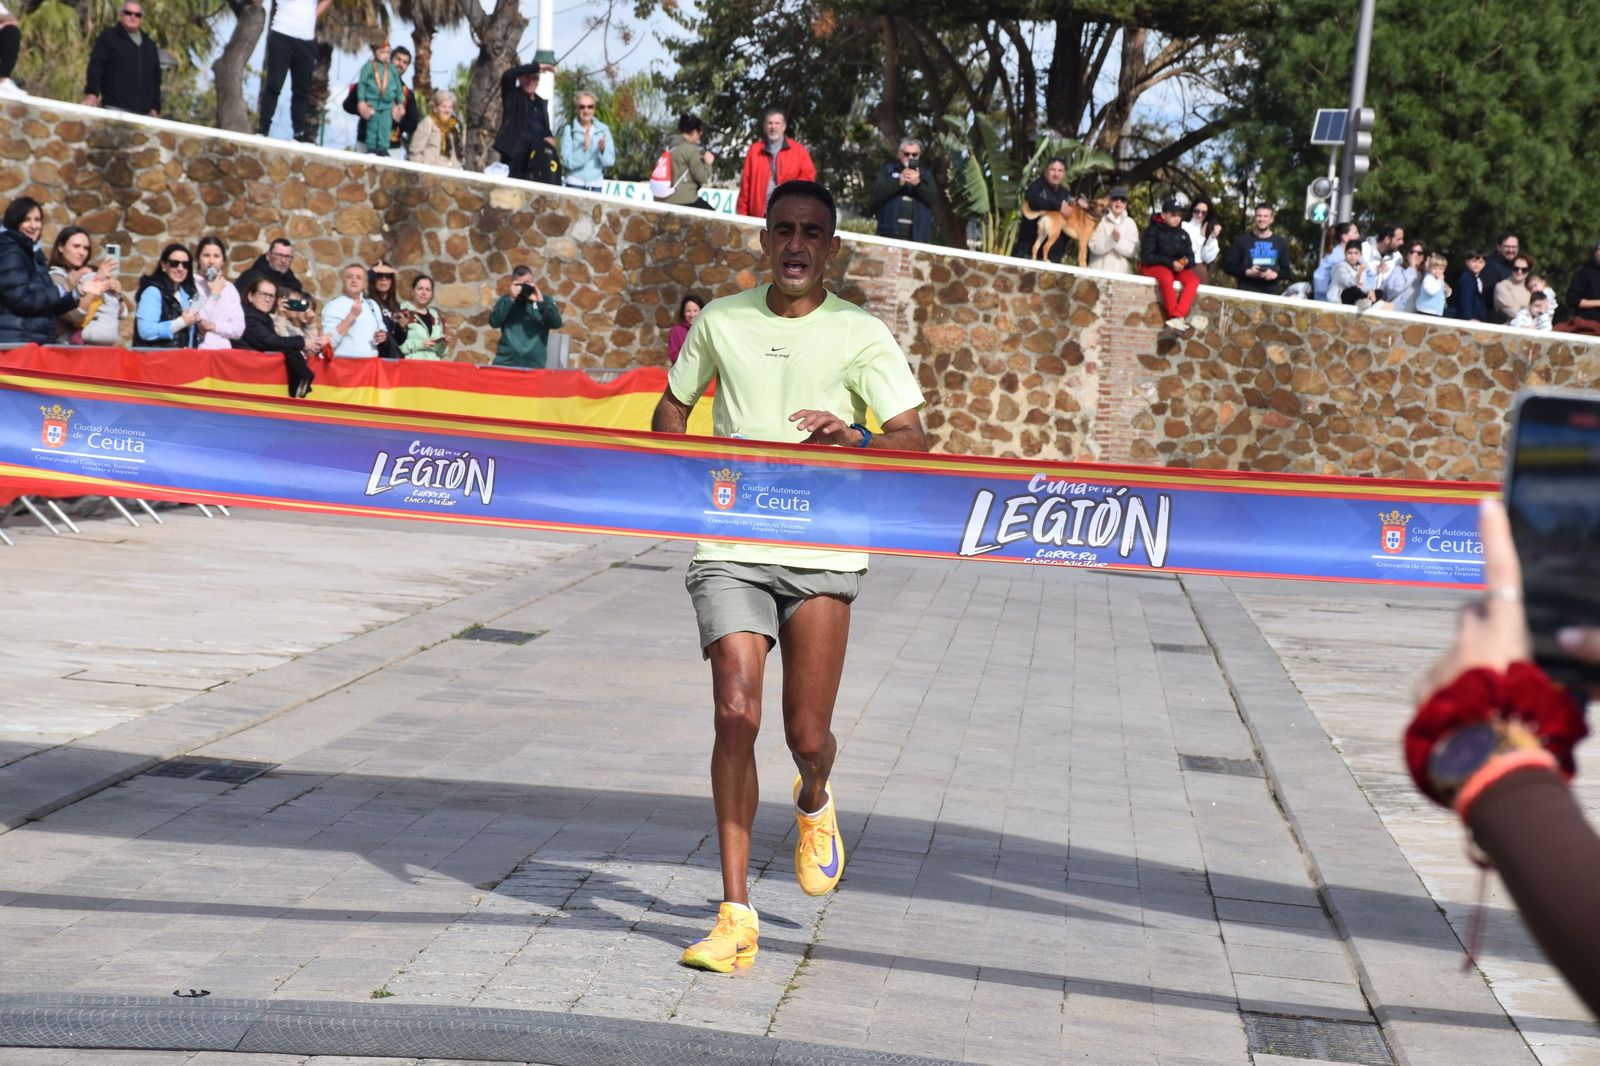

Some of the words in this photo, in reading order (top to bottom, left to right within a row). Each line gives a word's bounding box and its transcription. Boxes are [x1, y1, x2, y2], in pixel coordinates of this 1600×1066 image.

[74, 422, 102, 434] Ciudad
[103, 425, 146, 437] Autónoma
[72, 430, 84, 440] de
[87, 432, 145, 453] Ceuta
[408, 440, 445, 457] Cuna
[365, 451, 496, 505] LEGIÓN
[1028, 472, 1087, 494] Cuna
[742, 484, 769, 492] Ciudad
[770, 486, 811, 495] Autónoma
[741, 492, 752, 500] de
[755, 492, 811, 512] Ceuta
[959, 487, 1170, 568] LEGIÓN
[1412, 527, 1441, 536] Ciudad
[1442, 528, 1480, 537] Autónom
[1426, 536, 1484, 554] Ceuta
